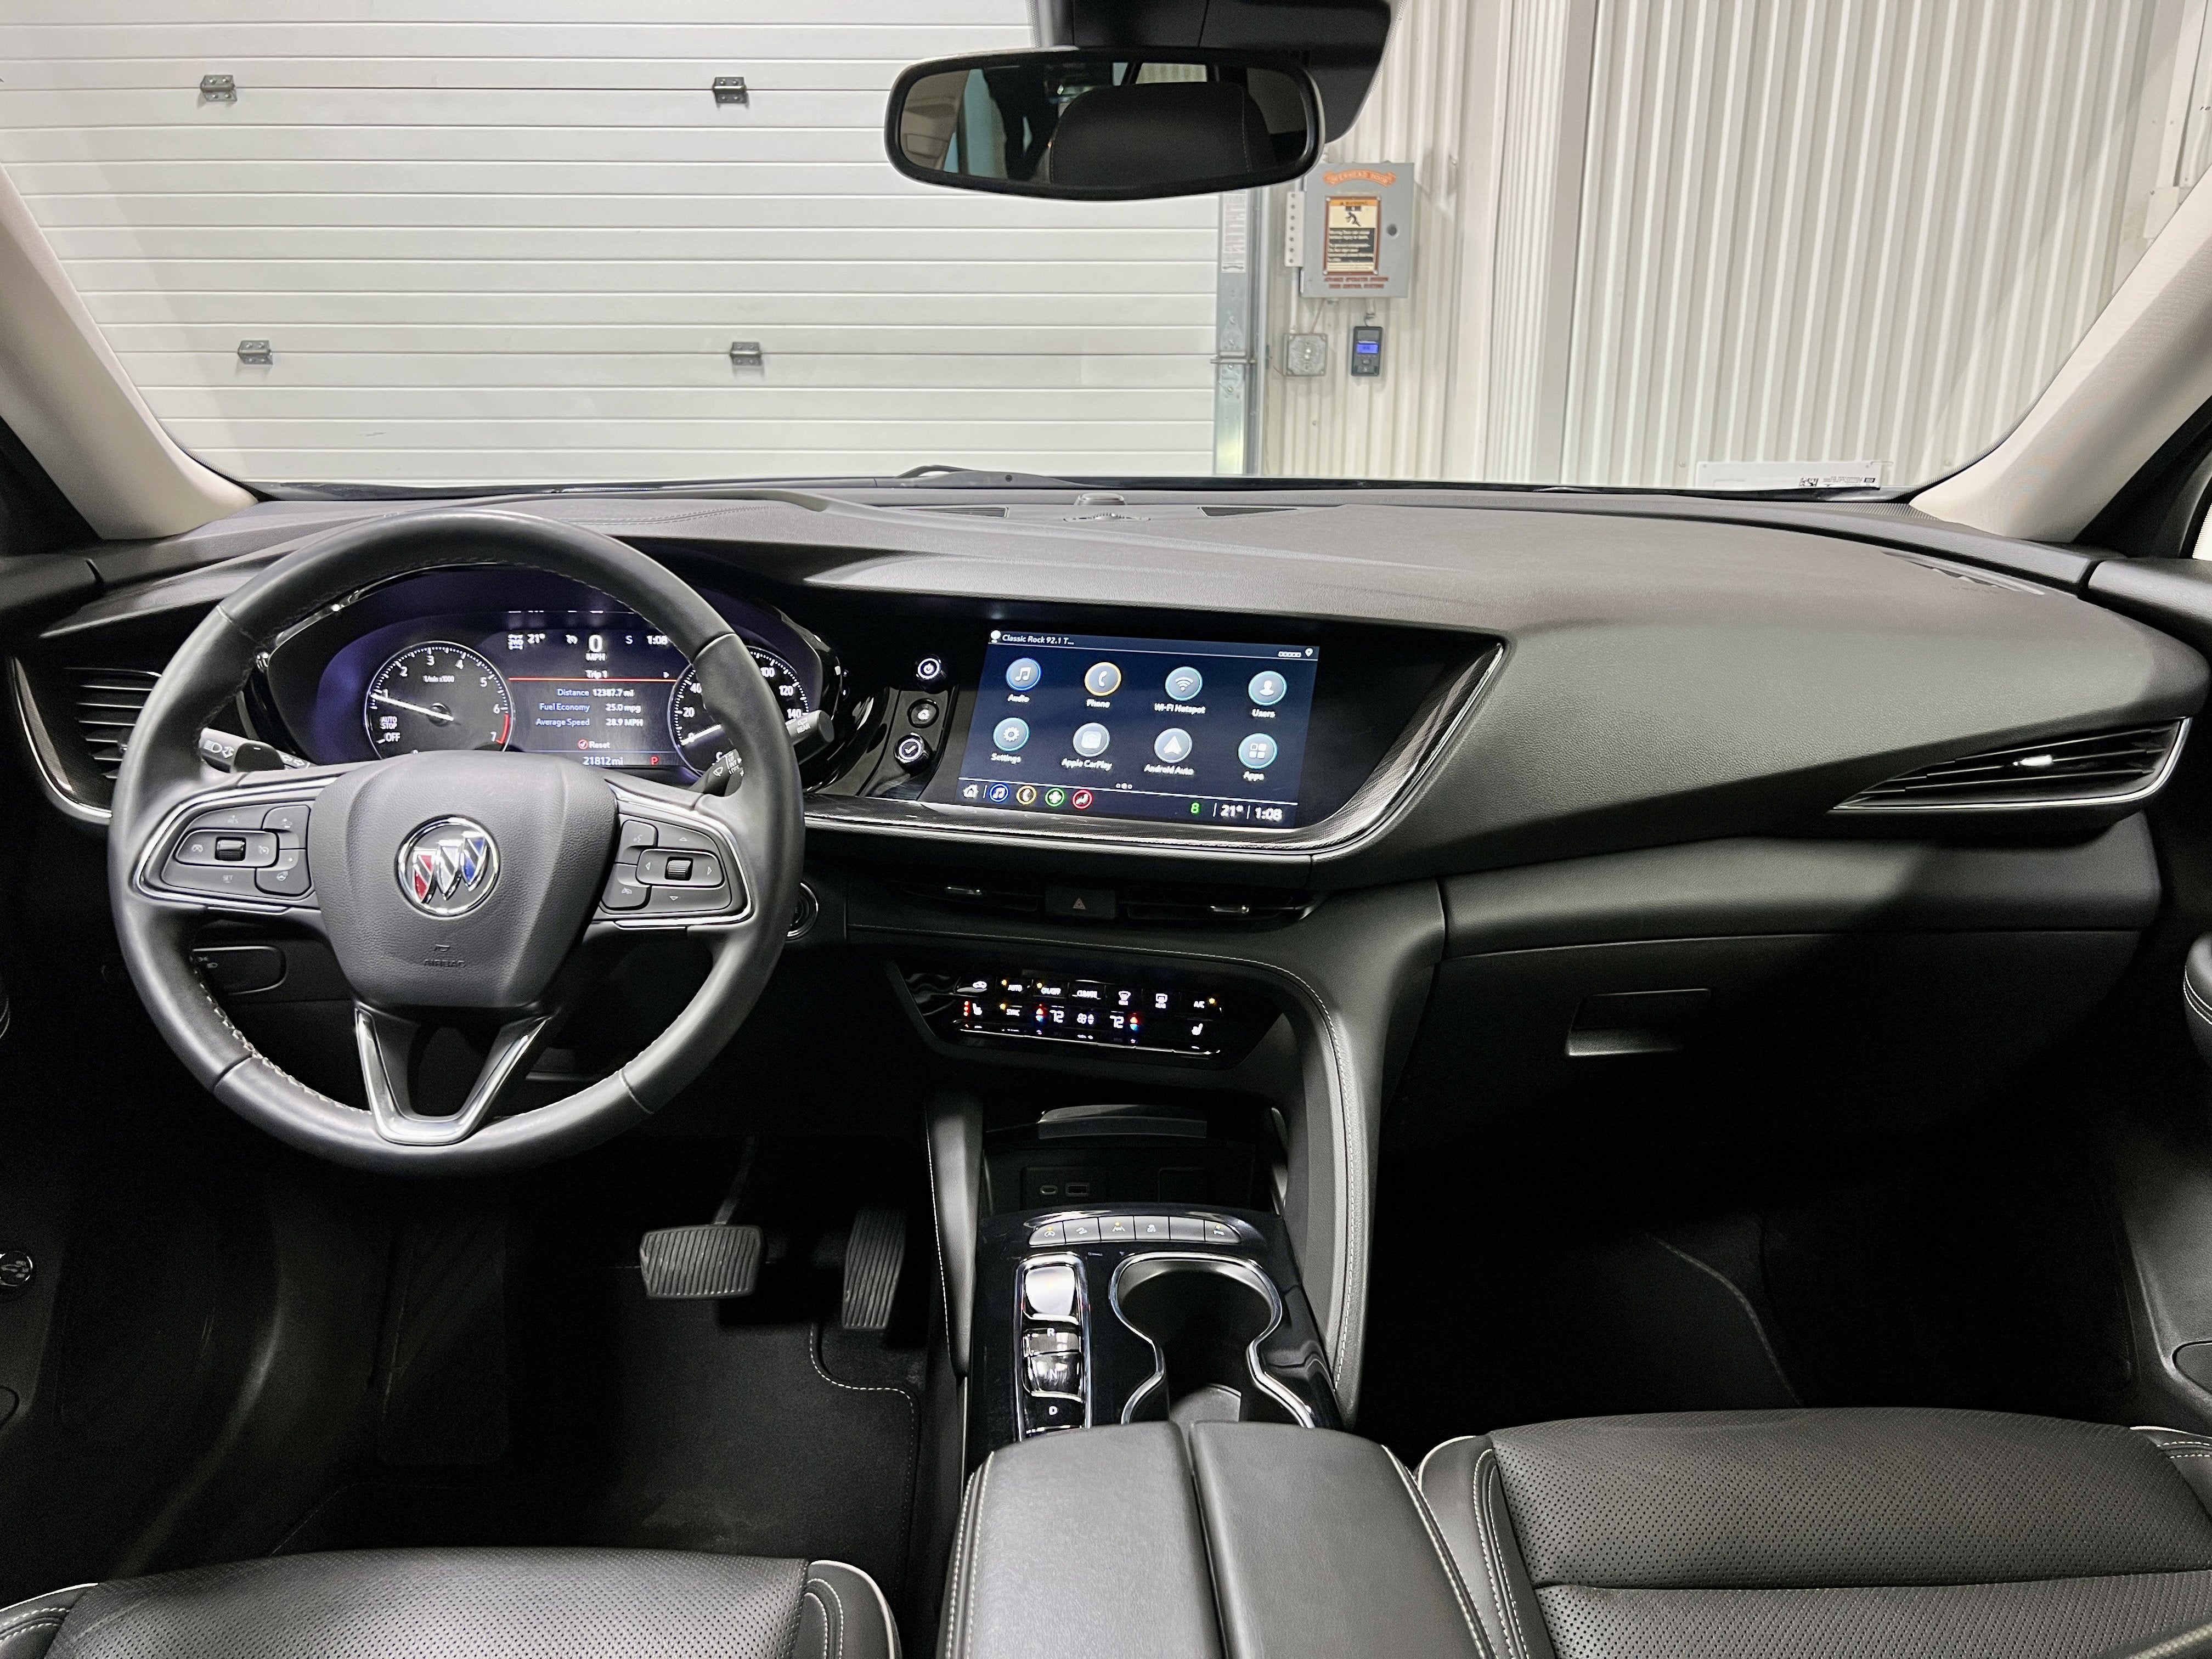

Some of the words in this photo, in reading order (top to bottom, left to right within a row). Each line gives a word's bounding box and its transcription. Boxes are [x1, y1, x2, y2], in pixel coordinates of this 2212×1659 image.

[589, 634, 603, 652] 0
[625, 635, 633, 644] S
[647, 635, 668, 645] 1:08
[1002, 634, 1026, 642] Classic
[427, 656, 435, 665] 3
[586, 653, 606, 661] MPH
[455, 659, 464, 669] 4
[400, 666, 408, 676] 2
[585, 670, 603, 679] Trip
[760, 667, 775, 677] 100
[481, 677, 487, 687] 5
[383, 689, 388, 698] 1
[557, 689, 590, 697] Distance
[623, 689, 634, 697] mi
[690, 684, 702, 693] 40
[780, 685, 793, 696] 120
[1007, 694, 1030, 703] Audio
[1086, 698, 1110, 708] Phone
[494, 704, 500, 713] 6
[539, 703, 555, 712] Fuel
[556, 703, 590, 713] Economy
[624, 704, 641, 713] mpg
[682, 707, 695, 717] 20
[1174, 704, 1206, 715] Hotspot
[1251, 708, 1276, 718] Users
[787, 709, 802, 719] 140
[536, 718, 566, 727] Average
[567, 718, 590, 727] Speed
[605, 718, 624, 726] 28.9
[624, 718, 643, 726] MPH
[385, 733, 400, 741] OFF
[490, 732, 496, 741] 7
[651, 757, 658, 765] P
[991, 753, 1021, 764] Settings
[1061, 758, 1083, 768] Apple
[1084, 759, 1112, 771] CarPlay
[1144, 764, 1174, 774] Android
[1173, 766, 1195, 776] Auto
[1243, 771, 1265, 781] Apps
[1255, 806, 1283, 821] 1:08
[1049, 1009, 1065, 1023] 72
[1109, 1015, 1125, 1029] 72
[1047, 1328, 1056, 1337] R
[1049, 1369, 1057, 1379] N
[1048, 1406, 1058, 1415] D
